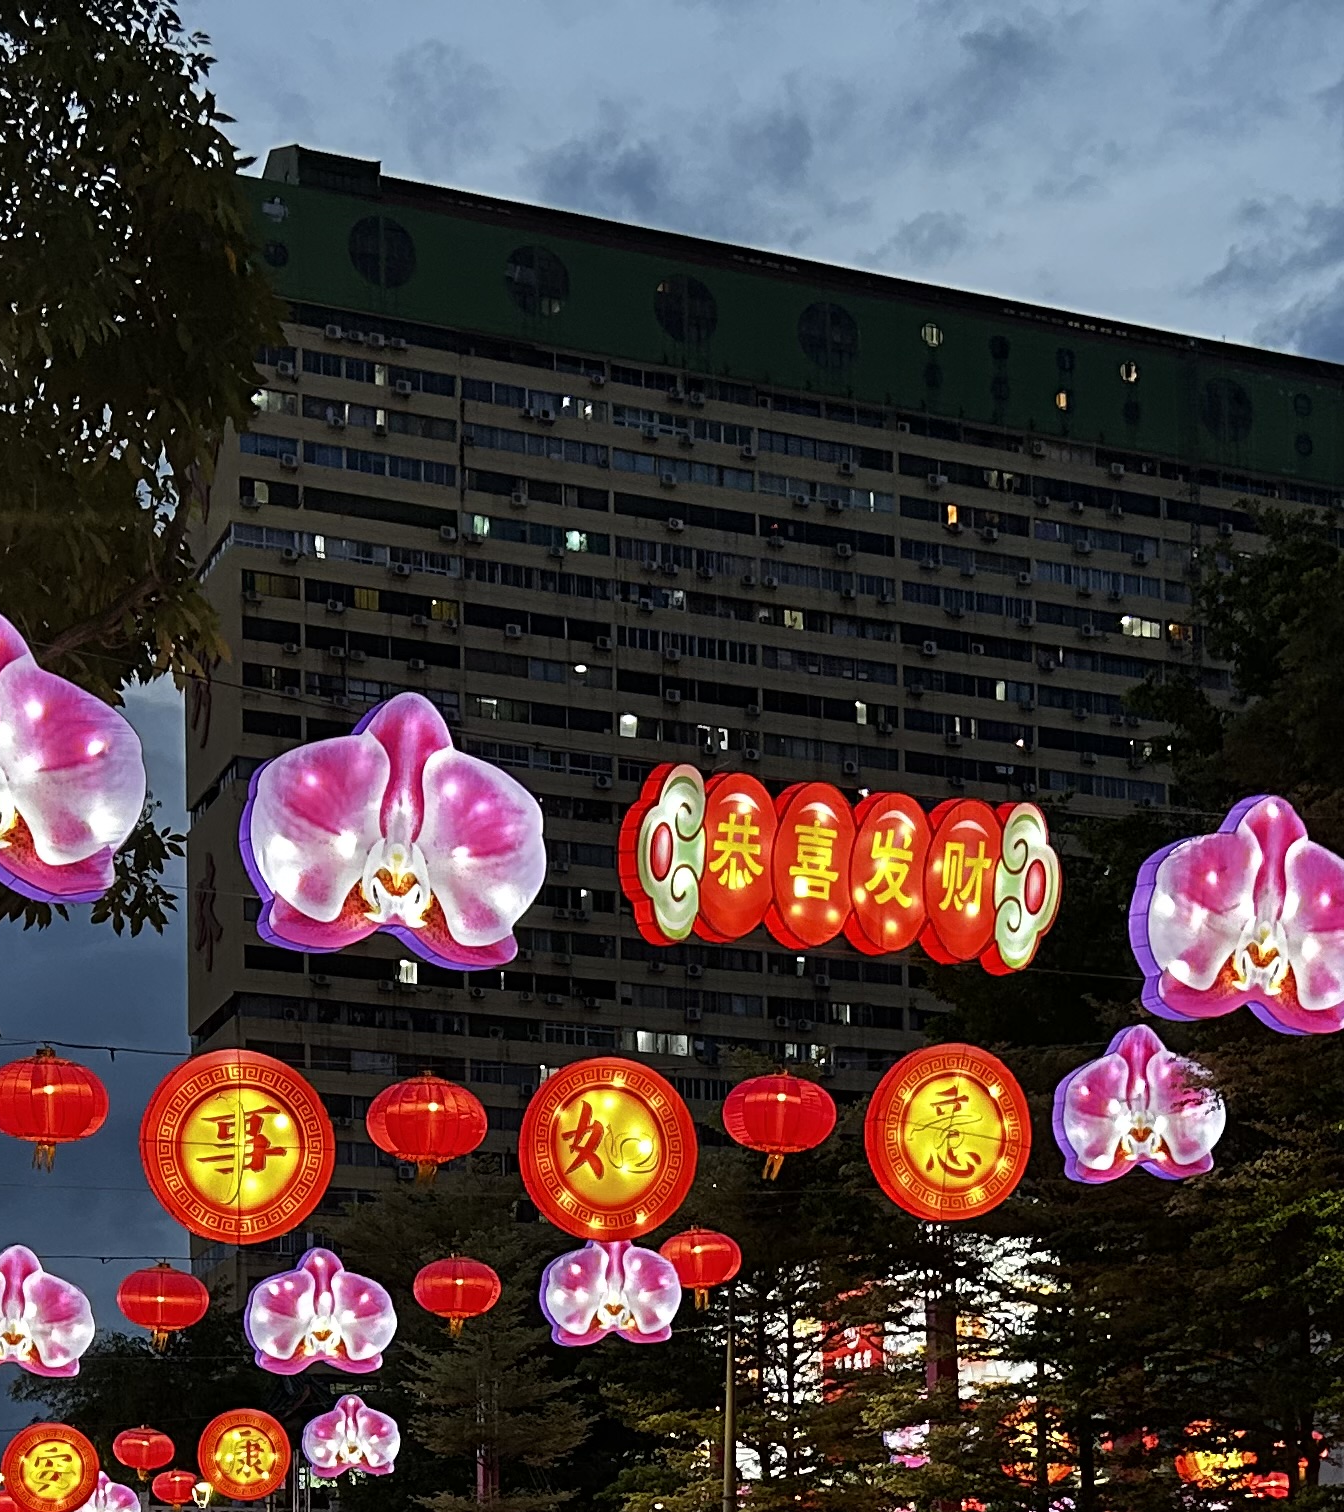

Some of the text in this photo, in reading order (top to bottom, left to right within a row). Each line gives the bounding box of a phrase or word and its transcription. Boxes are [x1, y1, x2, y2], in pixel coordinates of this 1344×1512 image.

[708, 814, 993, 914] 恭喜发财
[196, 1094, 288, 1206] 事
[561, 1100, 660, 1181] 如
[906, 1085, 984, 1179] 意
